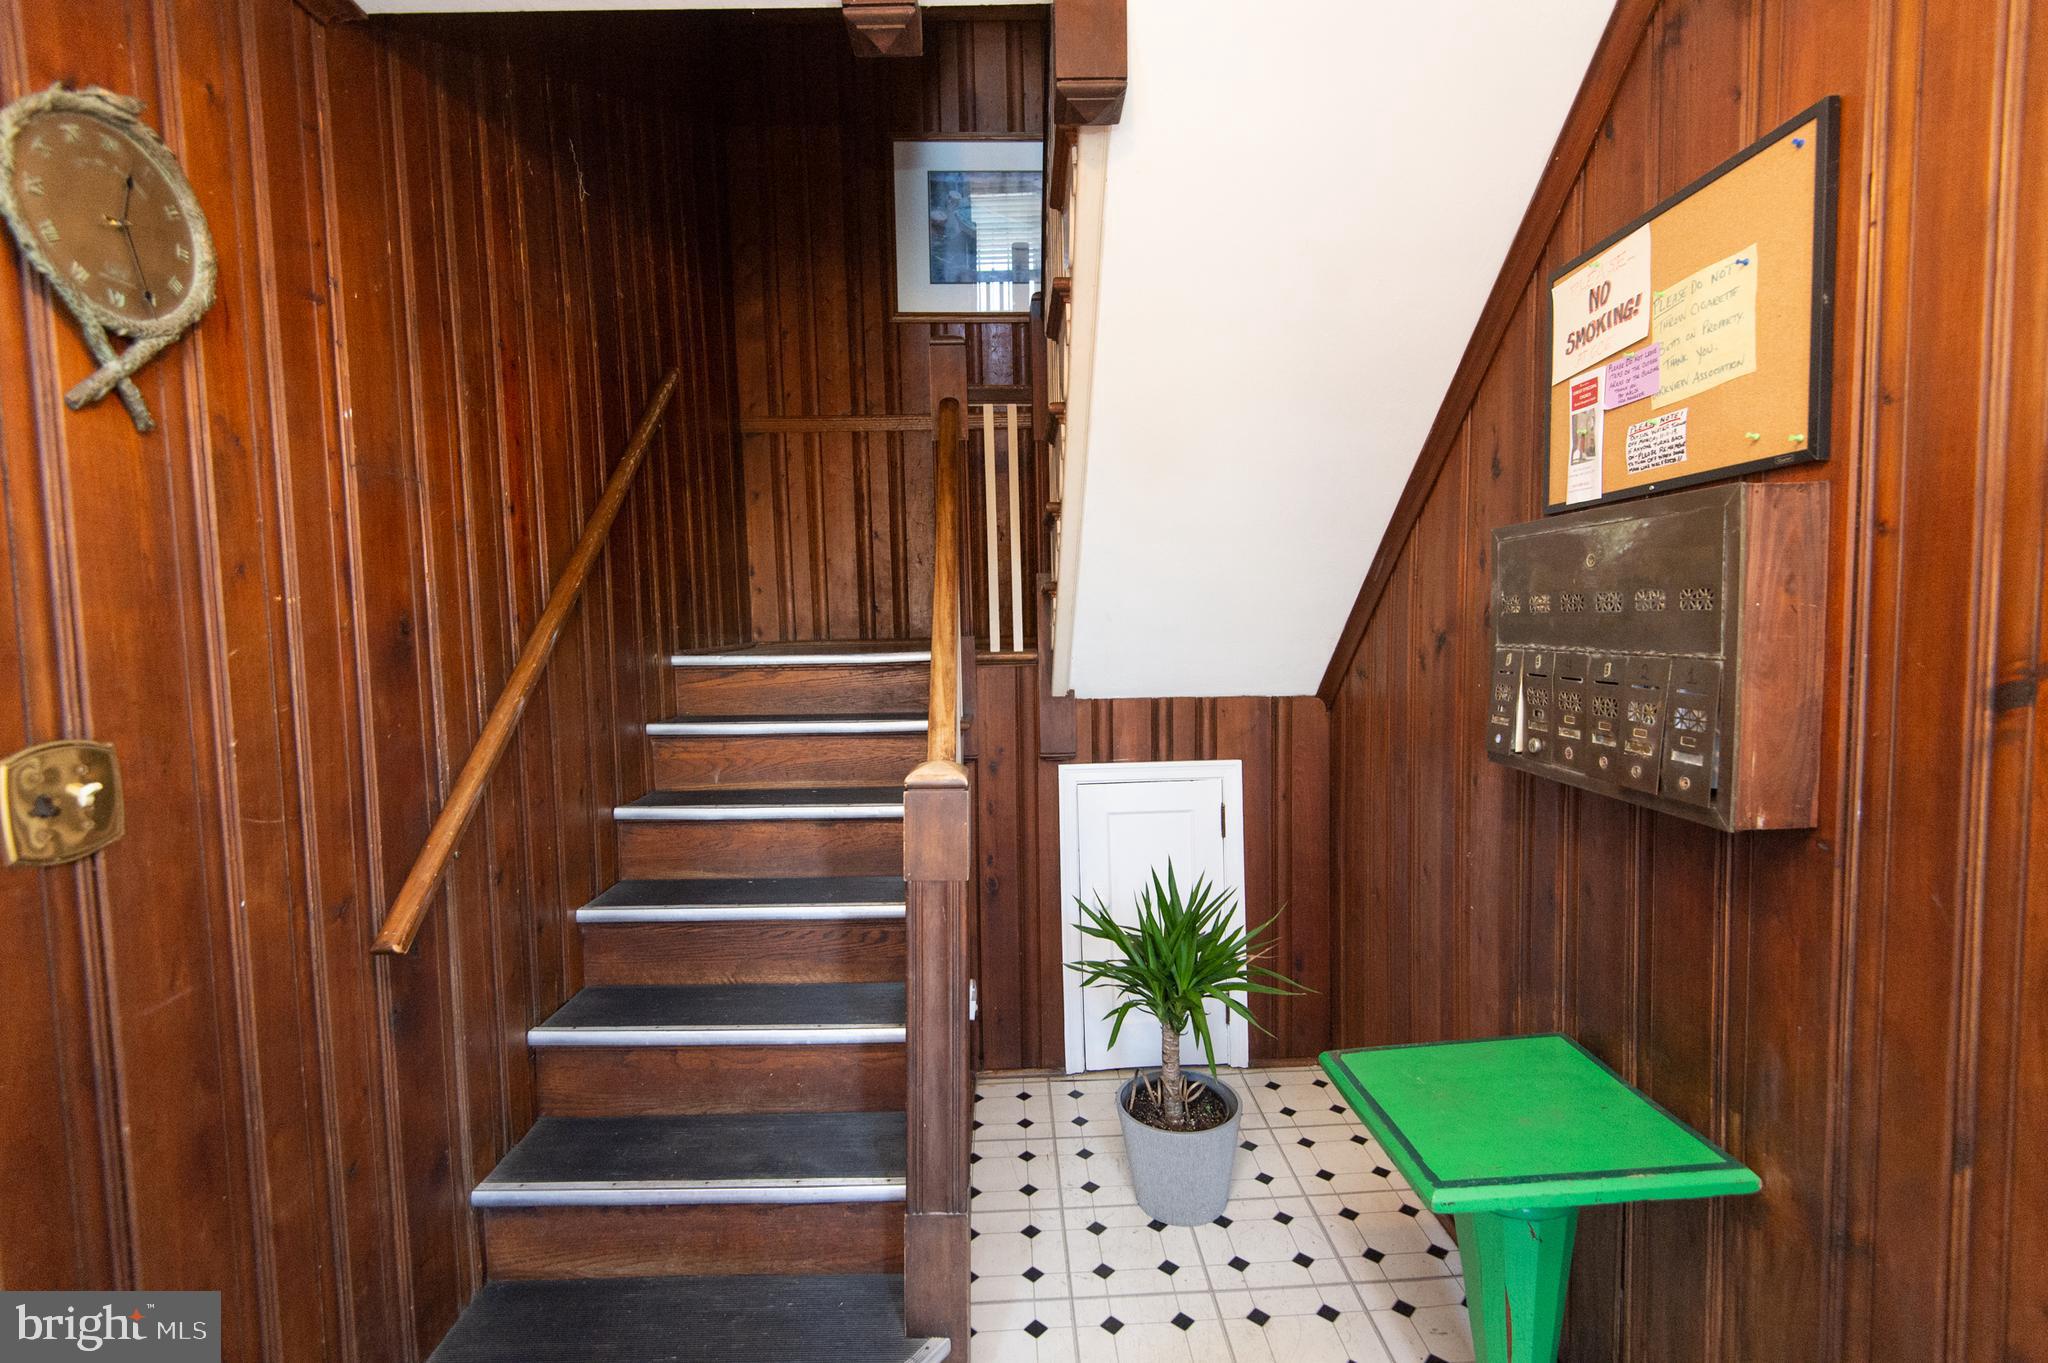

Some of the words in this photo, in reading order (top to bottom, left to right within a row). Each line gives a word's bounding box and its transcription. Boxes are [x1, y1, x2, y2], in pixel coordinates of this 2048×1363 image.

[1588, 279, 1611, 314] NO
[1653, 287, 1687, 318] PLEASE
[1711, 264, 1733, 284] NOT
[1565, 292, 1643, 356] SMOKING!
[1685, 327, 1696, 341] ON
[1662, 353, 1689, 370] THANK
